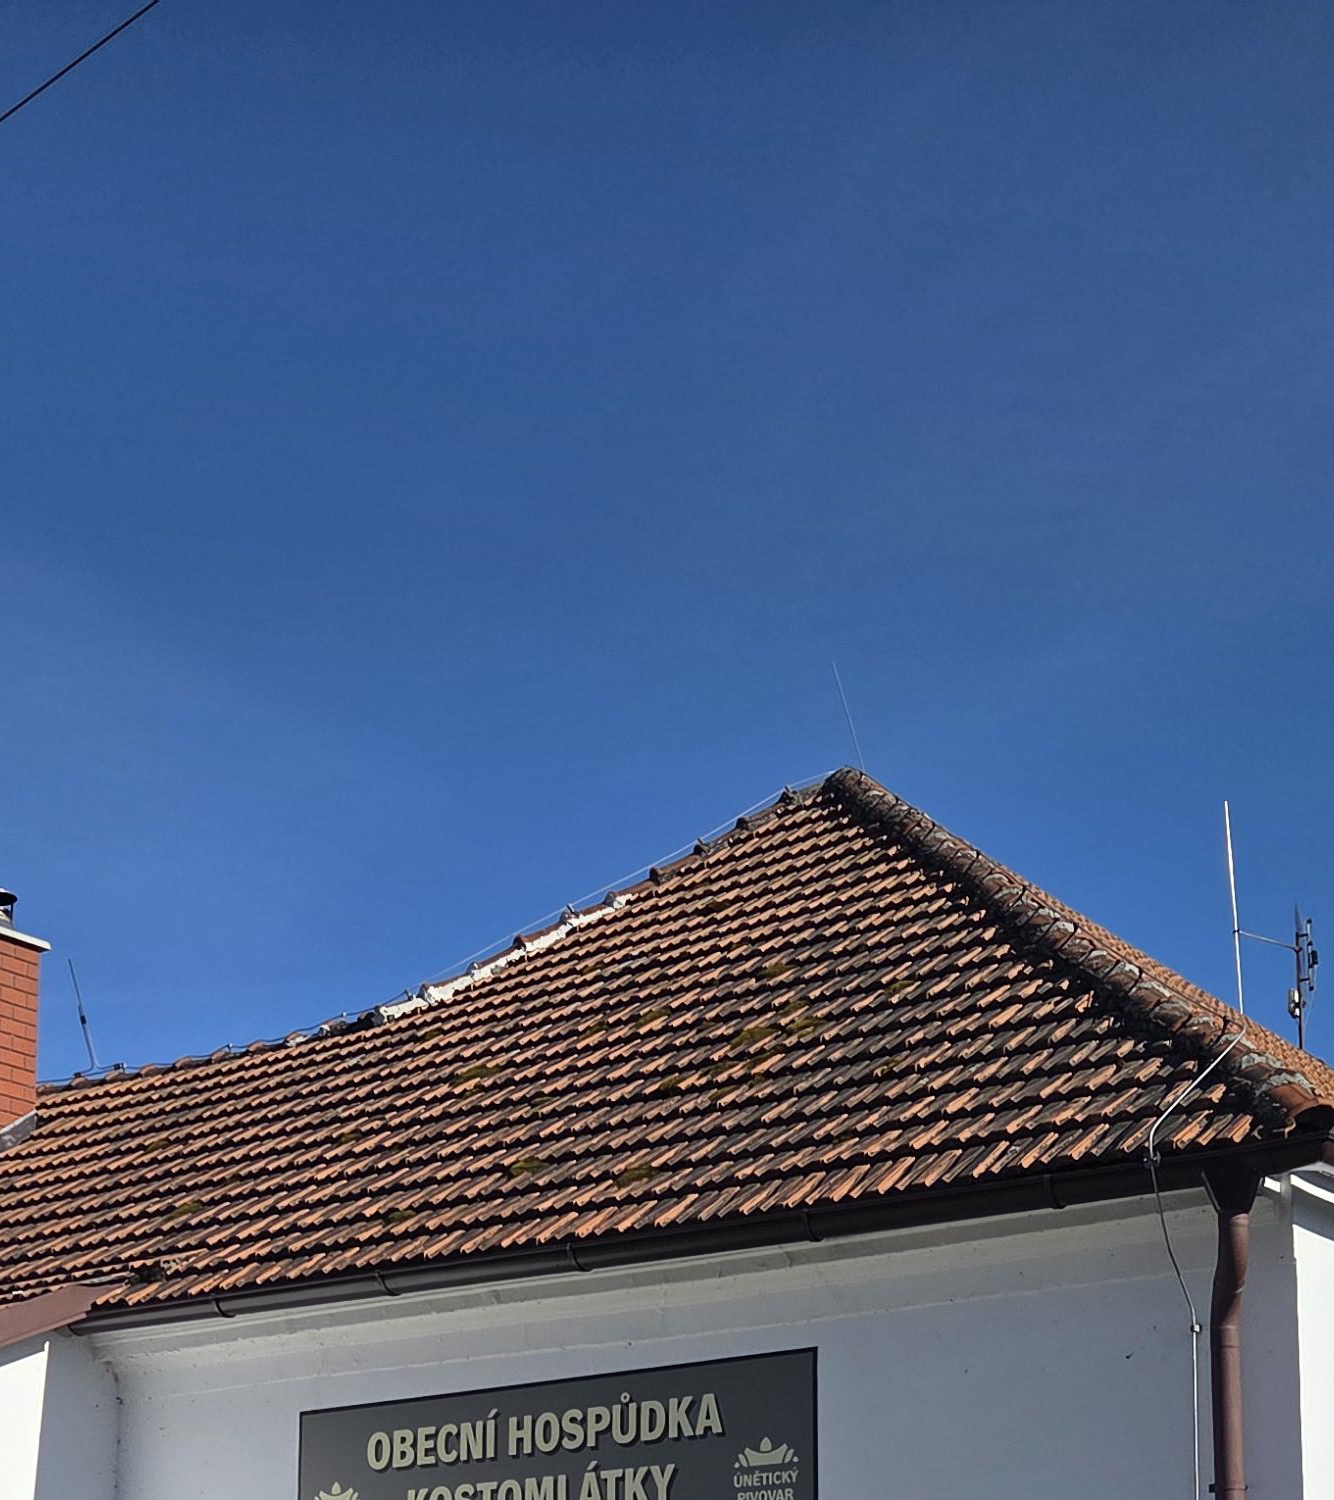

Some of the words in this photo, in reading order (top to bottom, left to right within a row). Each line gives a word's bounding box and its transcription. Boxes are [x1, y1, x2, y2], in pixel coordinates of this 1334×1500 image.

[367, 1408, 499, 1473] OBECNÍ
[507, 1391, 723, 1457] HOSPŮDKA
[733, 1467, 799, 1490] ÚNĚTICKÝ
